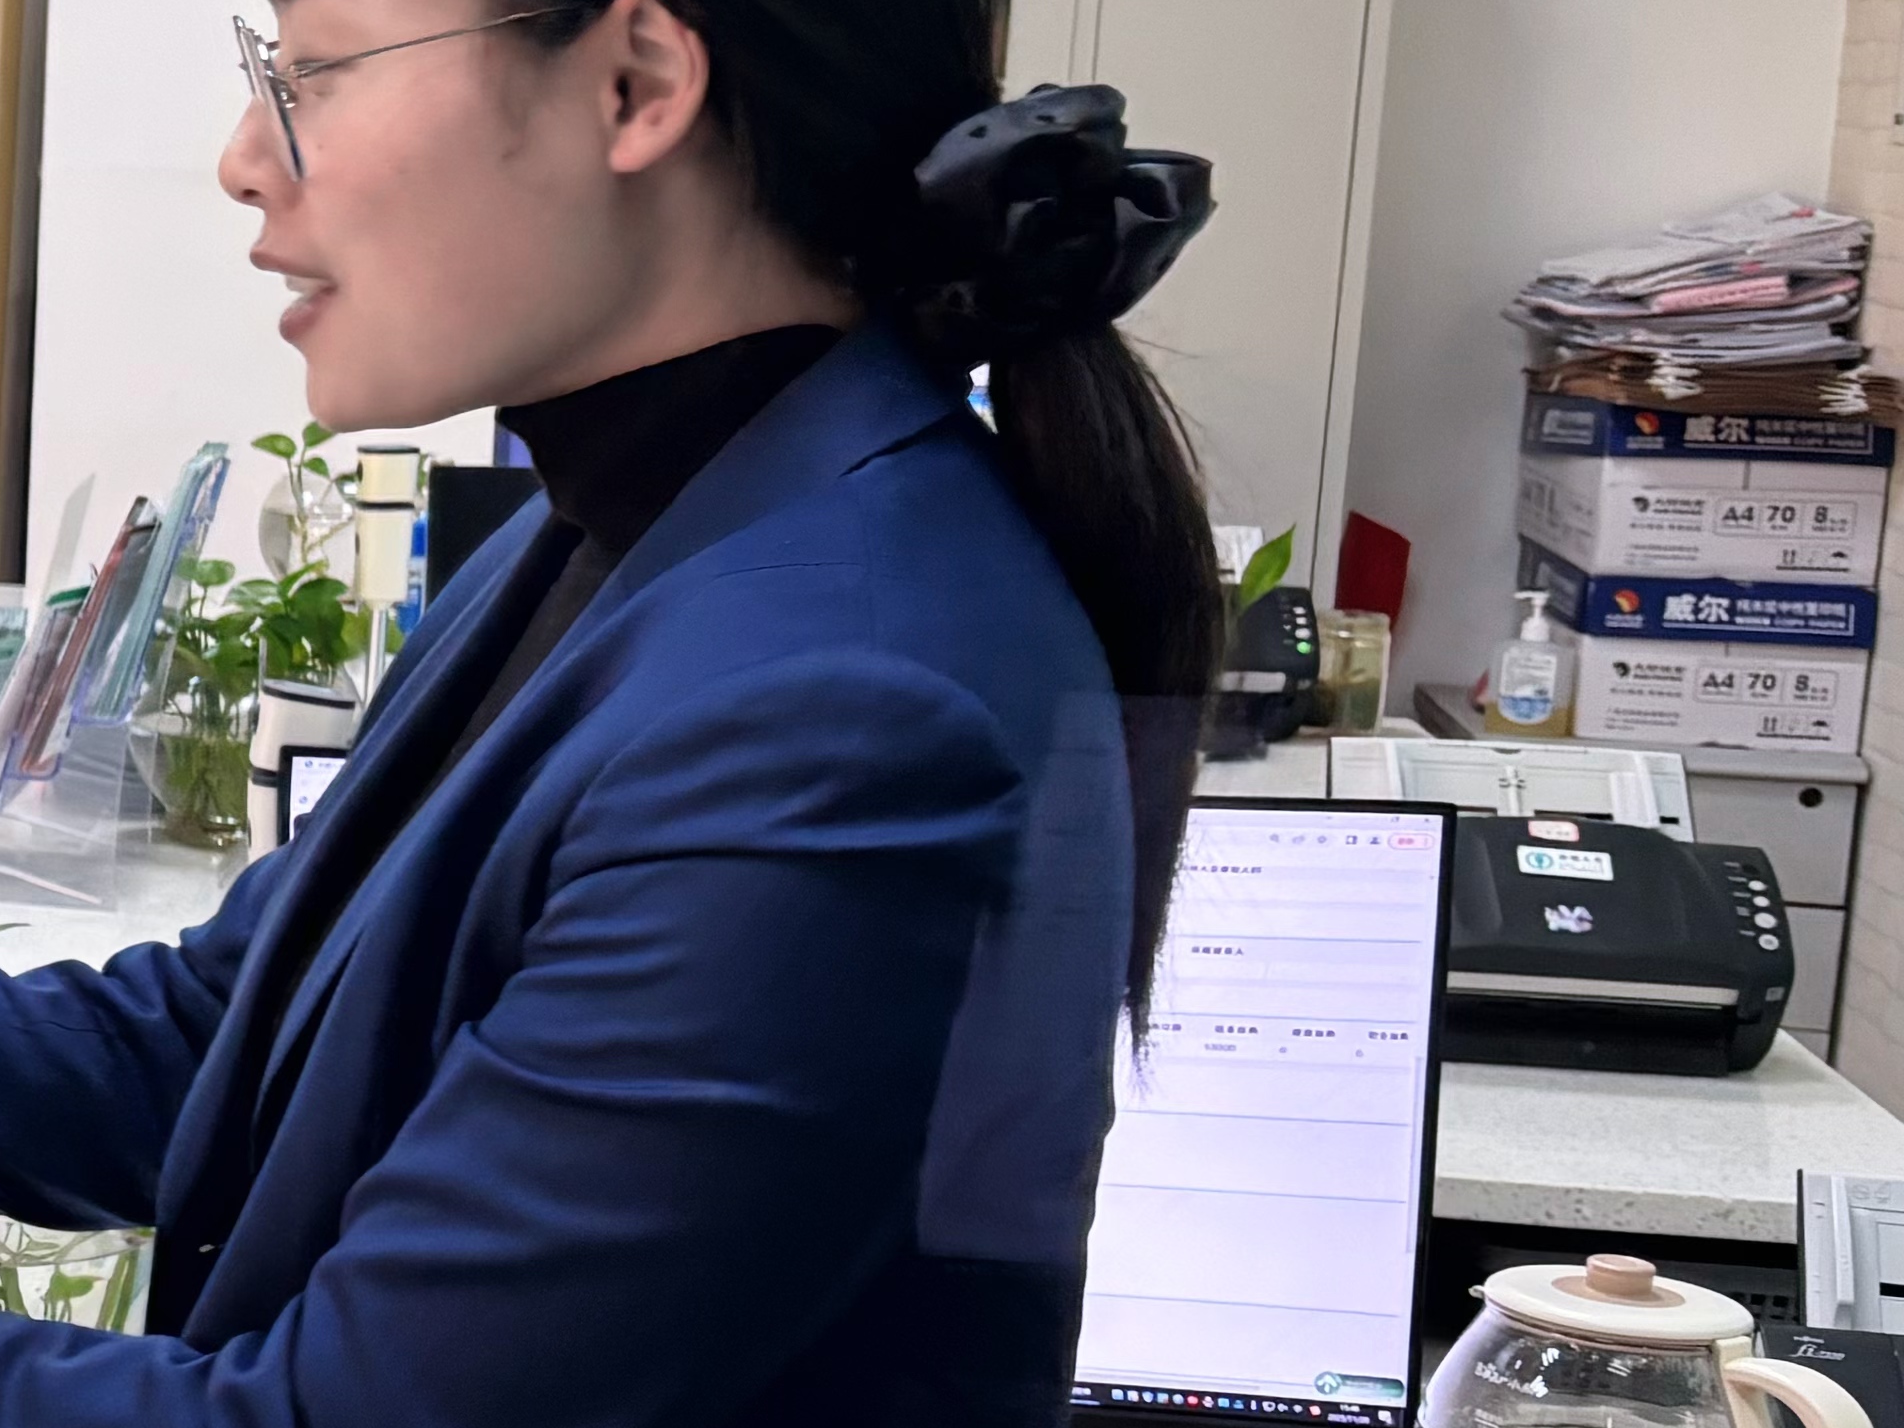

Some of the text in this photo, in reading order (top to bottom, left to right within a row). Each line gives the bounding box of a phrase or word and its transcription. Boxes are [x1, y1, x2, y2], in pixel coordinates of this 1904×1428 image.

[1684, 416, 1751, 442] 威尔
[1722, 506, 1754, 523] A4
[1767, 505, 1796, 523] 70
[1664, 594, 1730, 622] 威尔
[1703, 673, 1735, 690] A4
[1747, 673, 1777, 690] 70
